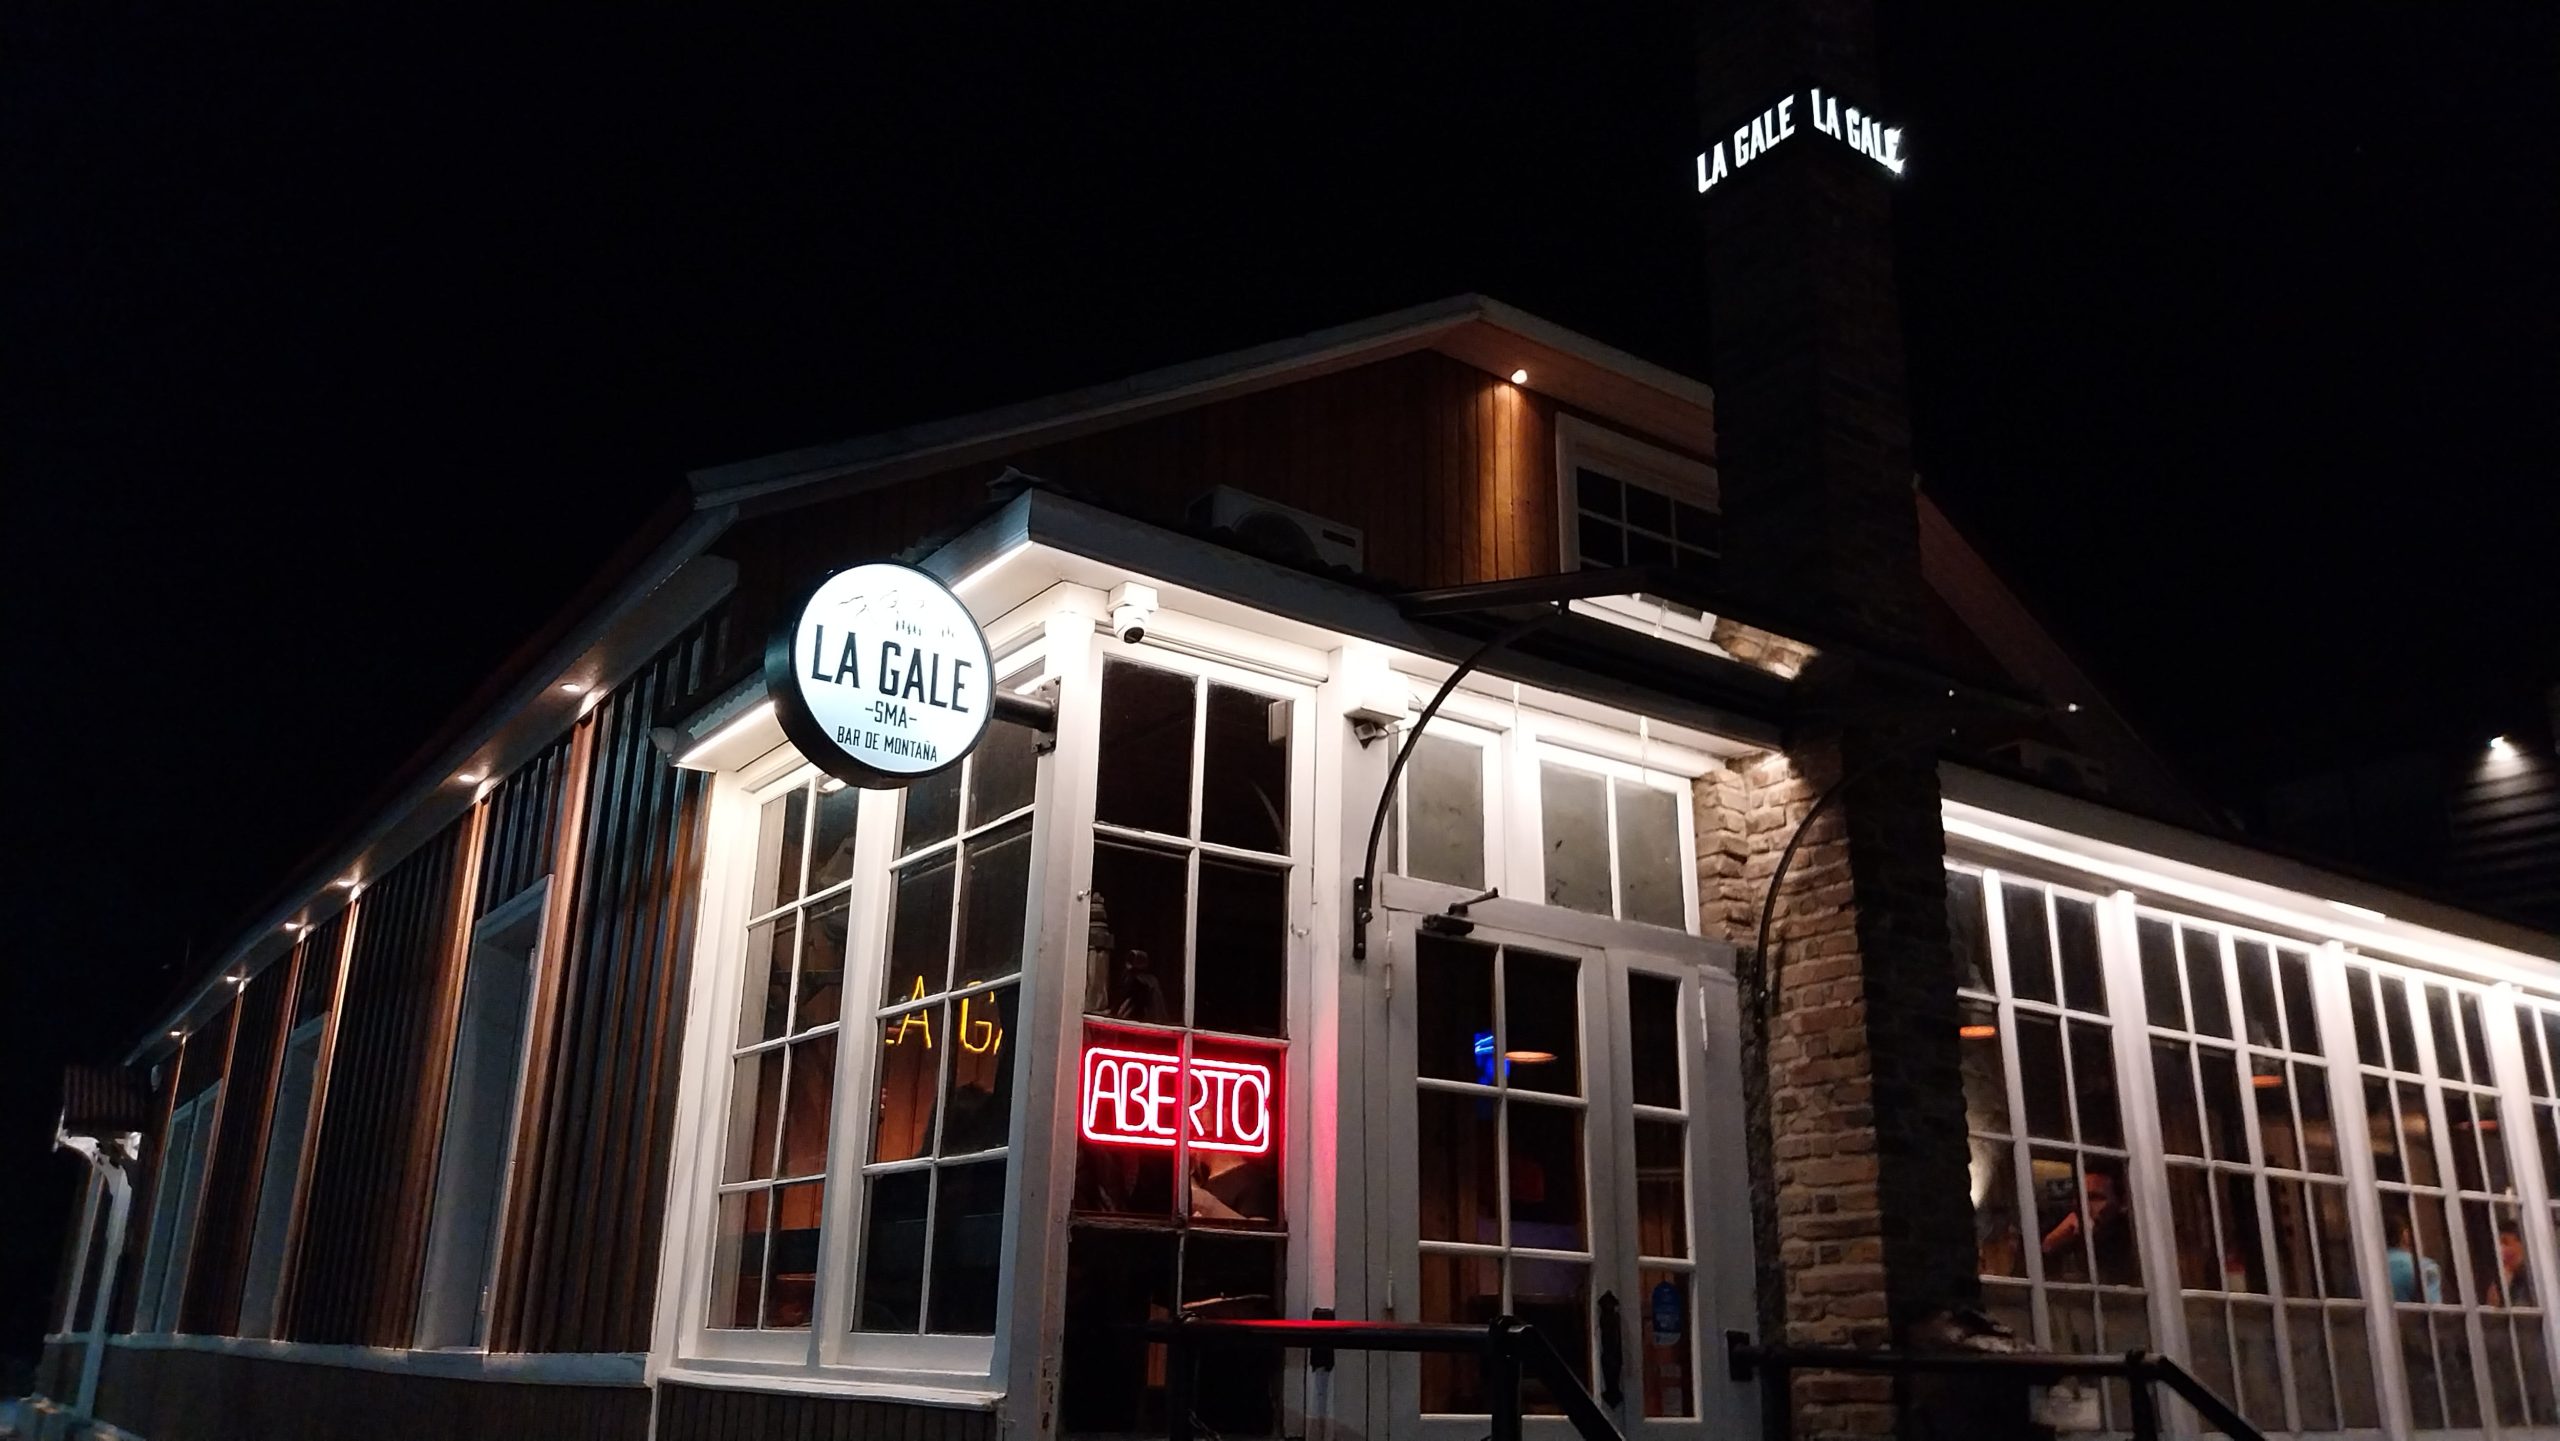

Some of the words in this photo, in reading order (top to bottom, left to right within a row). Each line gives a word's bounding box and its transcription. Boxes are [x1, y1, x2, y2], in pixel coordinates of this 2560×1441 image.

[1697, 141, 1728, 193] LA
[1733, 94, 1796, 168] GALE
[1811, 87, 1841, 141] LA
[1845, 106, 1905, 174] GALE
[811, 624, 860, 688] LA
[879, 640, 972, 713] GALE
[837, 725, 861, 747] BAR
[865, 731, 880, 750] DE
[884, 735, 938, 762] MONTAÑA
